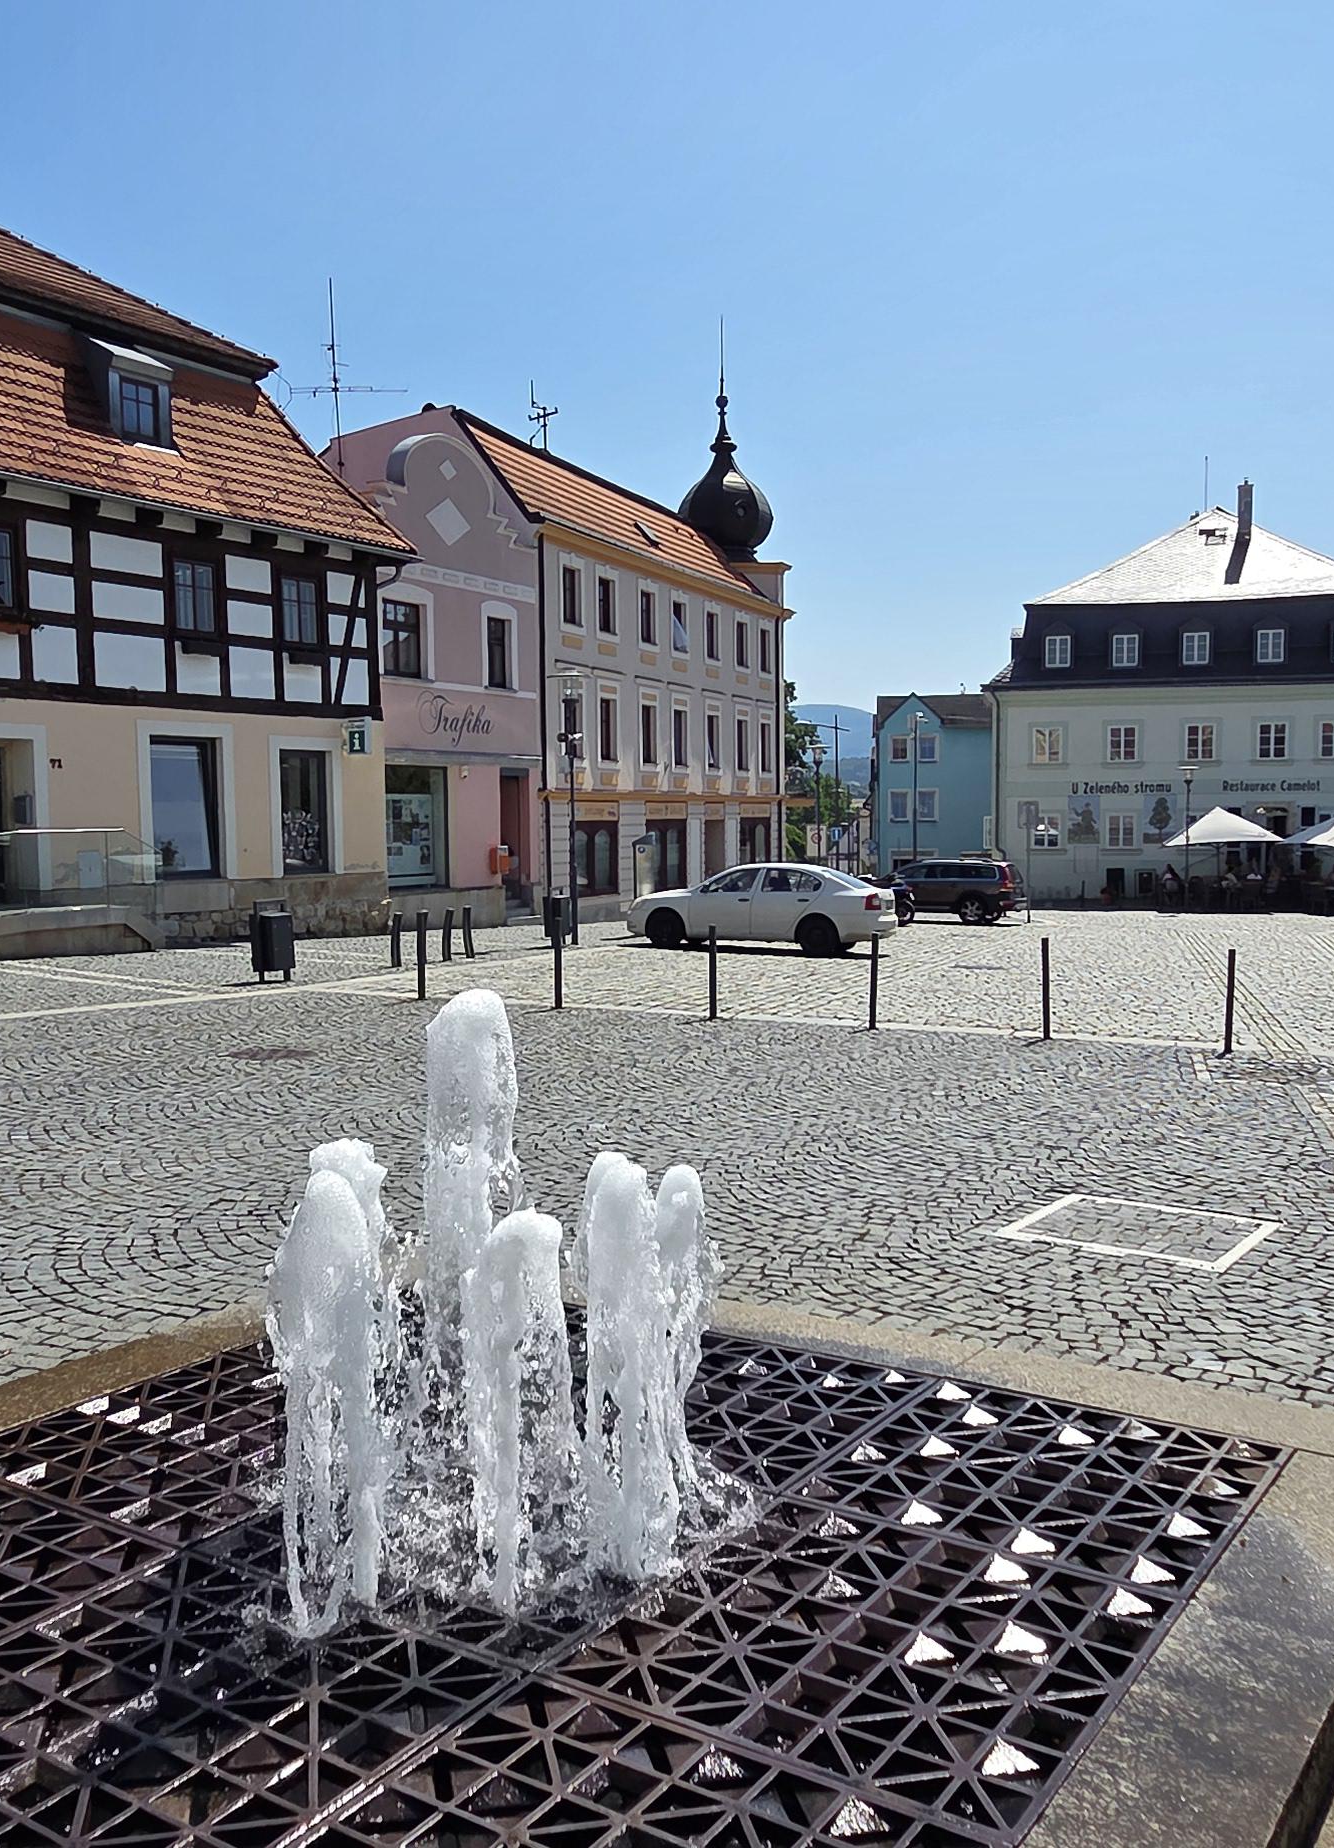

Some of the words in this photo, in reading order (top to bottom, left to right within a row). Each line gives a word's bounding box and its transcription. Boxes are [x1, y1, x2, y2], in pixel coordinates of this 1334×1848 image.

[416, 689, 495, 748] Trafika
[49, 758, 63, 770] 71
[1071, 782, 1079, 795] U
[1083, 781, 1130, 794] Zeleného
[1134, 781, 1172, 793] stromu
[1222, 780, 1276, 792] Restaurace
[1280, 780, 1320, 792] Camelot
